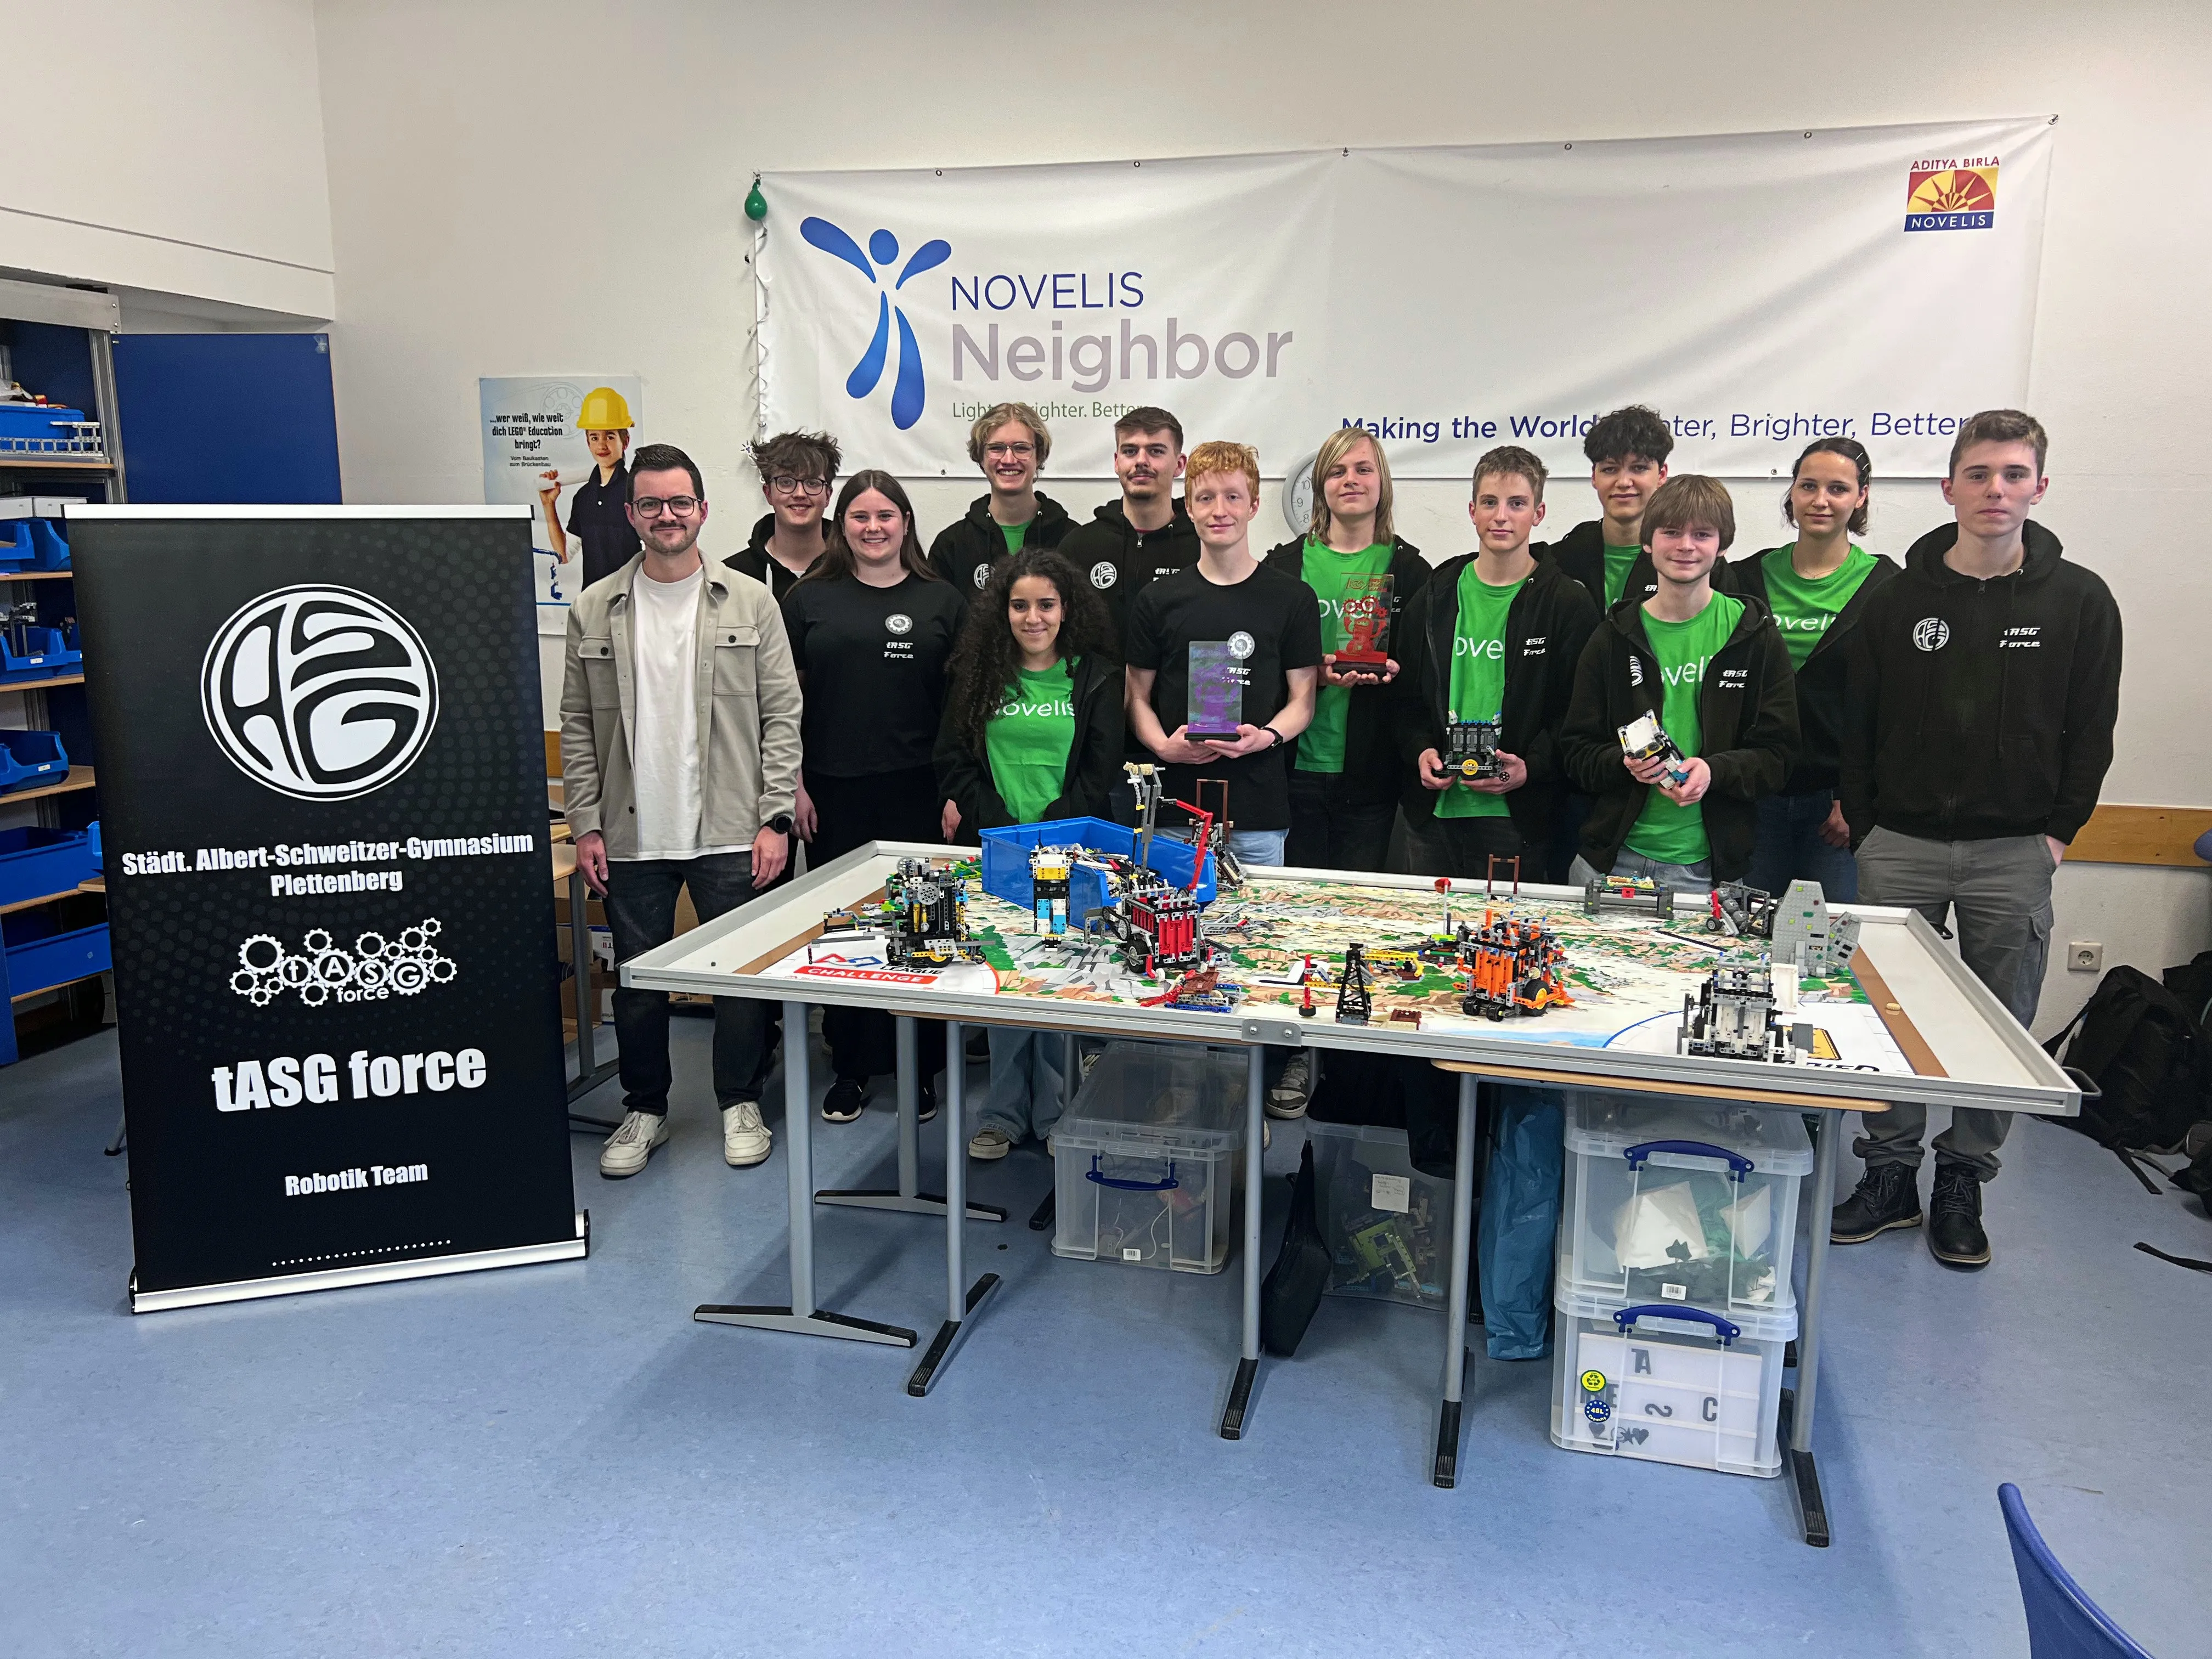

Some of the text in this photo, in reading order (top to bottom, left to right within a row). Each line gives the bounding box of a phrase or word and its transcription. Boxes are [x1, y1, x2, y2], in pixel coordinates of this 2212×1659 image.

[1911, 156, 2000, 171] ADITYA BIRLA
[1911, 215, 1986, 229] NOVELIS
[952, 272, 1144, 311] NOVELIS
[952, 318, 1293, 393] Neighbor
[532, 413, 545, 422] wie
[546, 413, 563, 422] weit
[492, 426, 506, 436] dich
[528, 426, 563, 436] Education
[1452, 416, 1497, 438] the
[1731, 413, 1856, 441] Brighter,
[515, 439, 541, 451] bringt?
[1302, 480, 1311, 490] 10
[1297, 498, 1304, 507] 9
[1303, 514, 1310, 523] 8
[122, 832, 533, 876] Städt. Albert-Schweitzer-Gymnasium
[271, 869, 403, 897] Plettenberg
[808, 968, 924, 982] CHALLENGE
[880, 966, 944, 975] LEAGUE
[337, 986, 390, 1003] force
[211, 1048, 486, 1111] tASG force
[285, 1164, 428, 1196] Robotik Team
